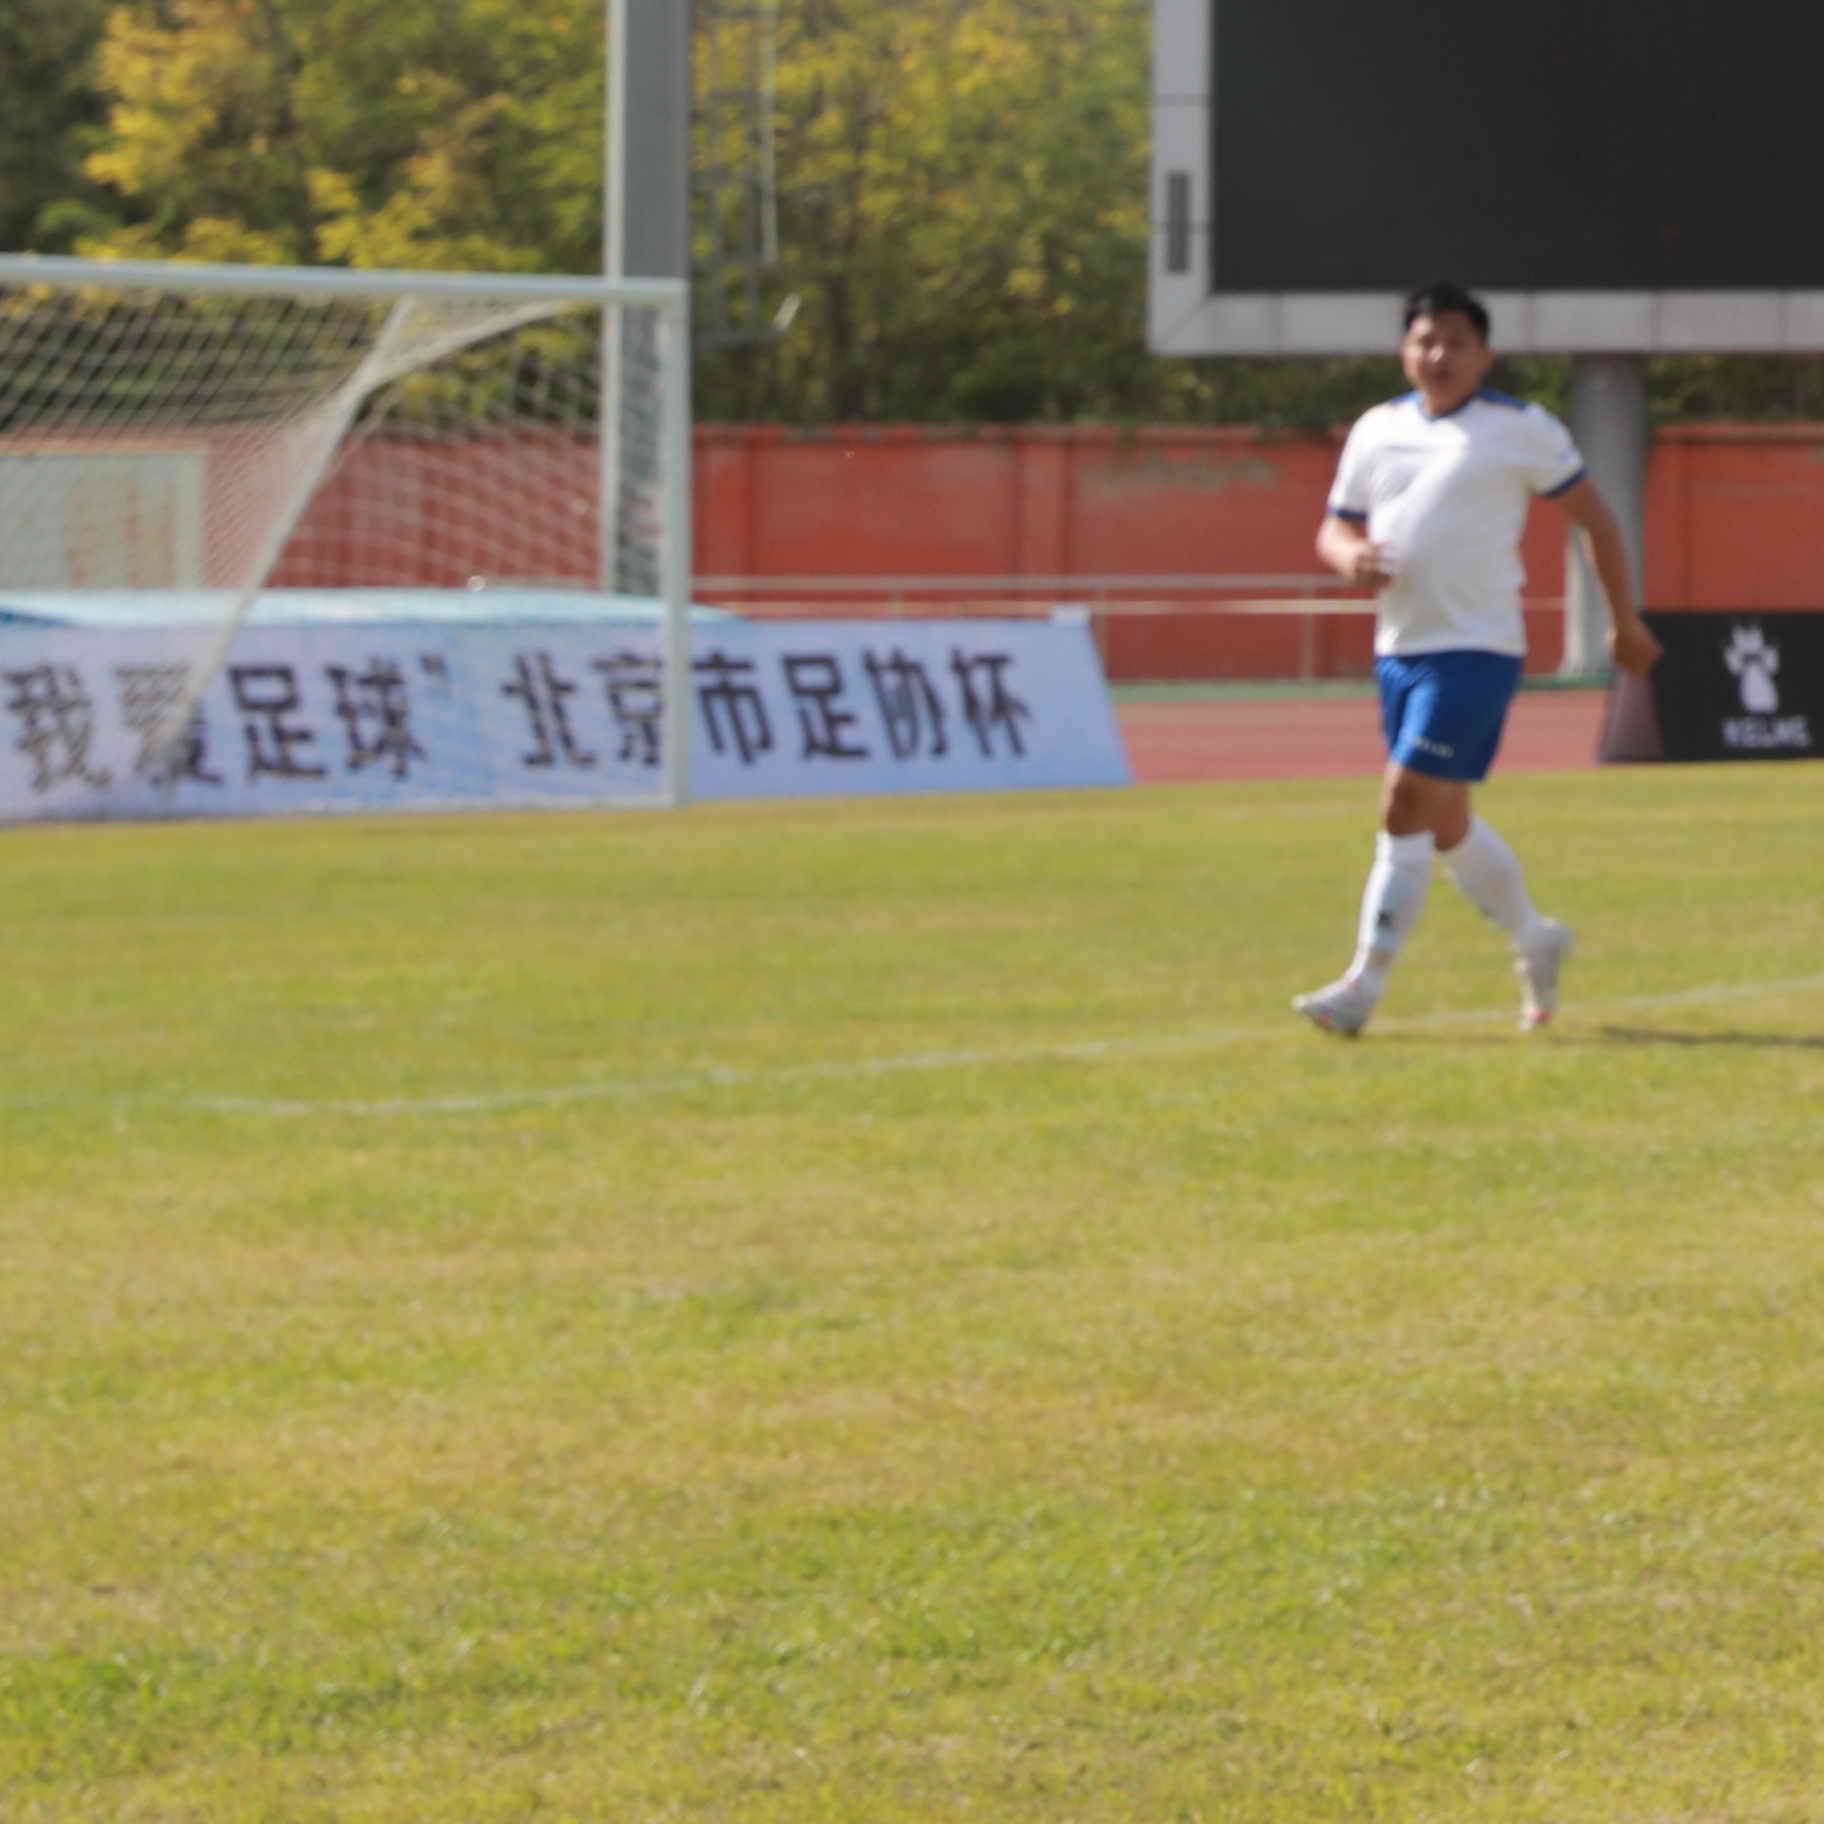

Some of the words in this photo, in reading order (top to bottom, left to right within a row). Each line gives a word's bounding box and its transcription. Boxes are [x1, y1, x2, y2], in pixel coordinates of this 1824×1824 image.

[502, 648, 1032, 767] 北京市足协杯
